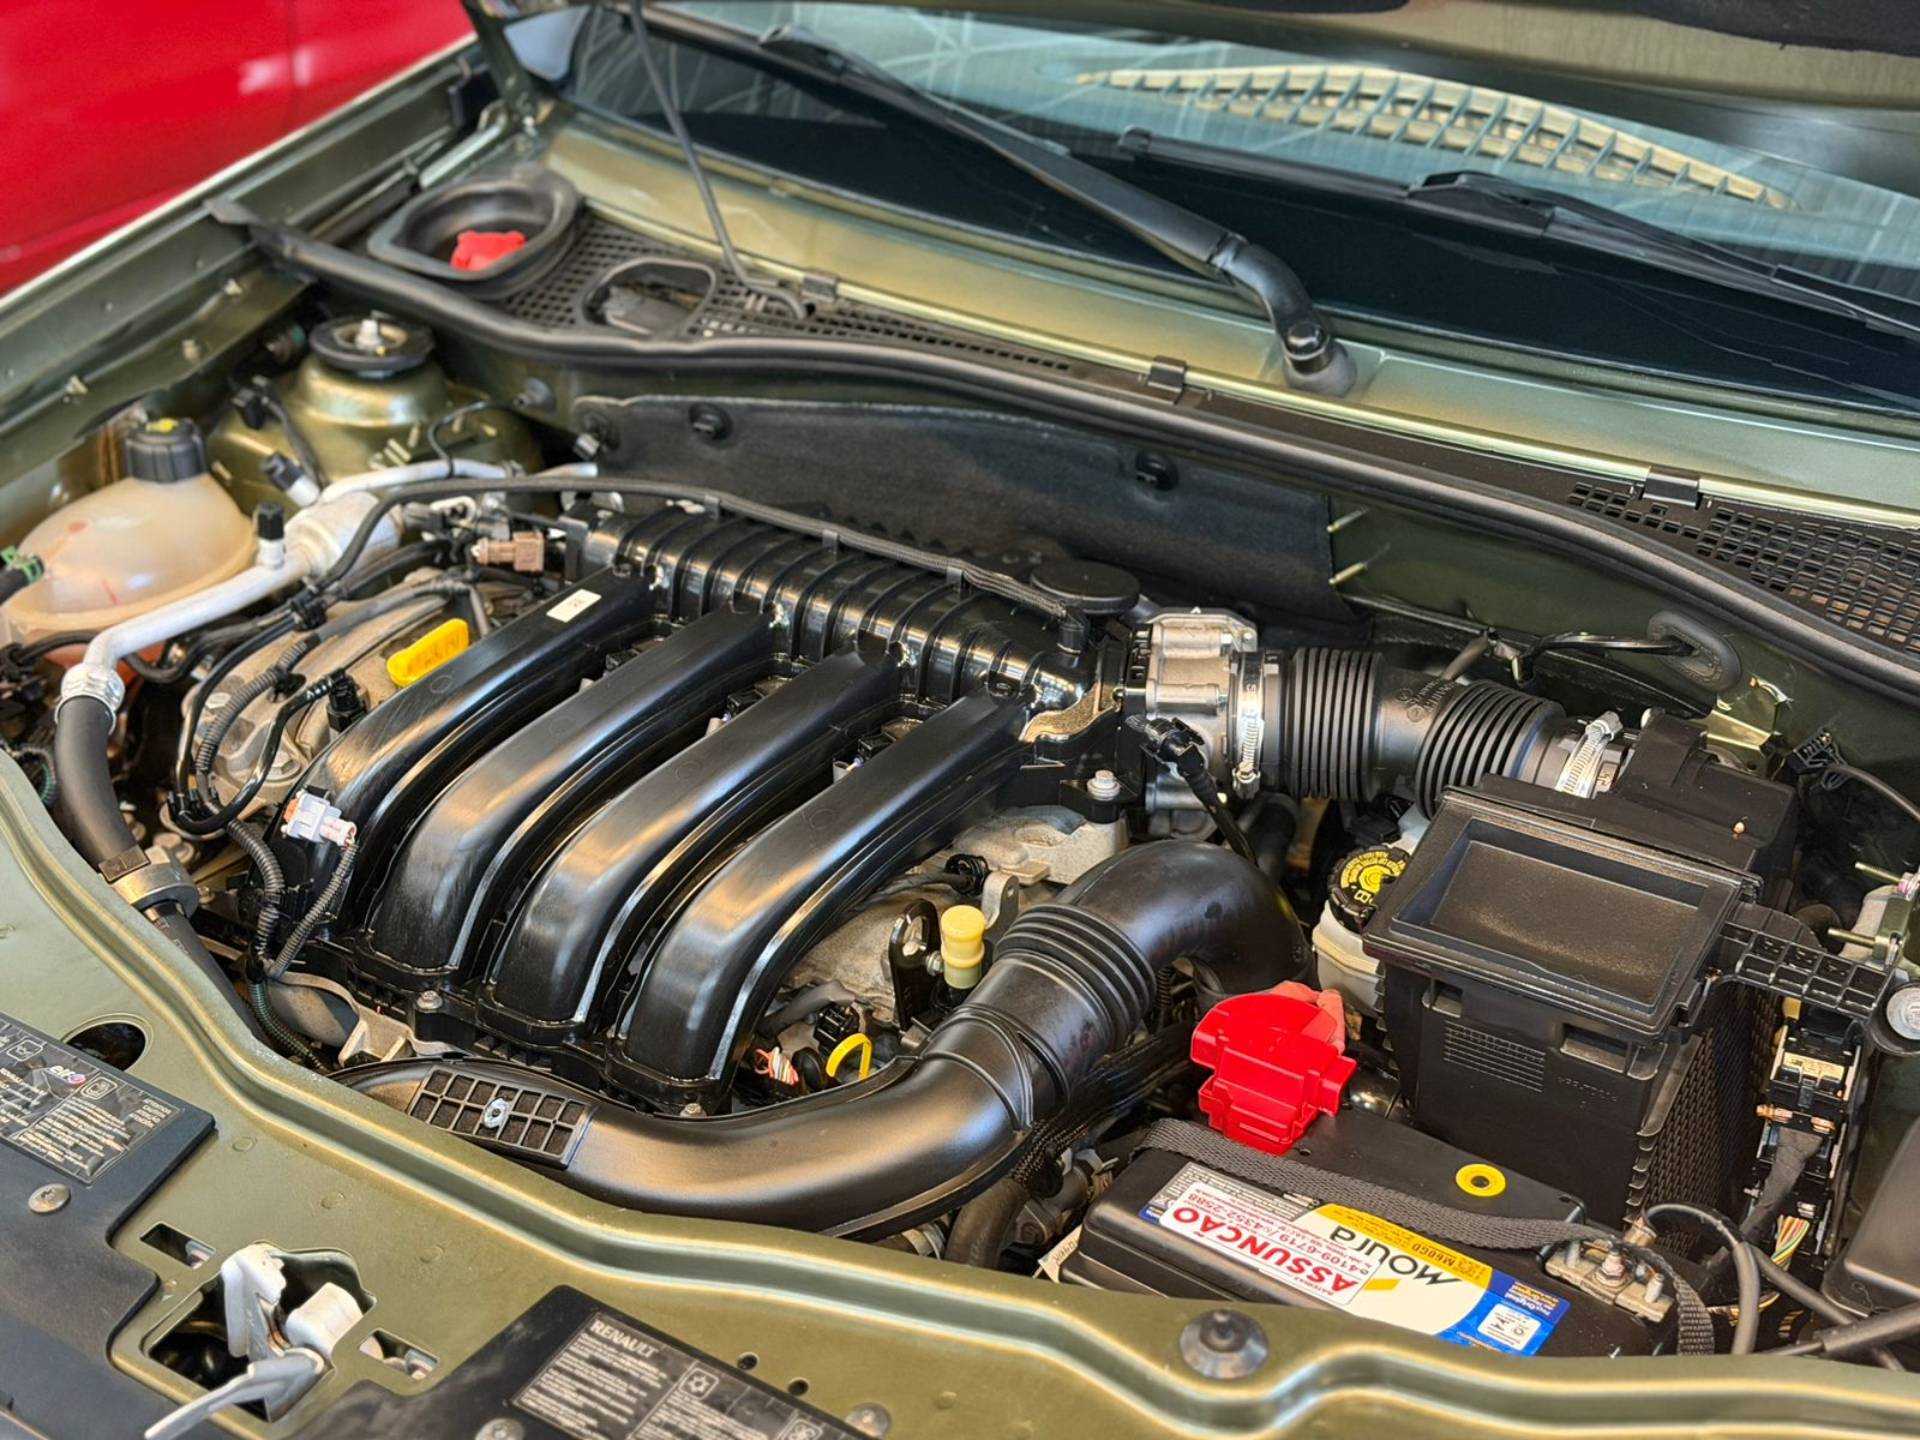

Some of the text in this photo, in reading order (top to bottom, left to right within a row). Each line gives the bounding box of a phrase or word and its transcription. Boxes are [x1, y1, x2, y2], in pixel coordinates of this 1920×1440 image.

[1188, 1192, 1263, 1231] 4352-2588
[1279, 1233, 1359, 1273] 4109-6719
[590, 1318, 659, 1359] RENAULT
